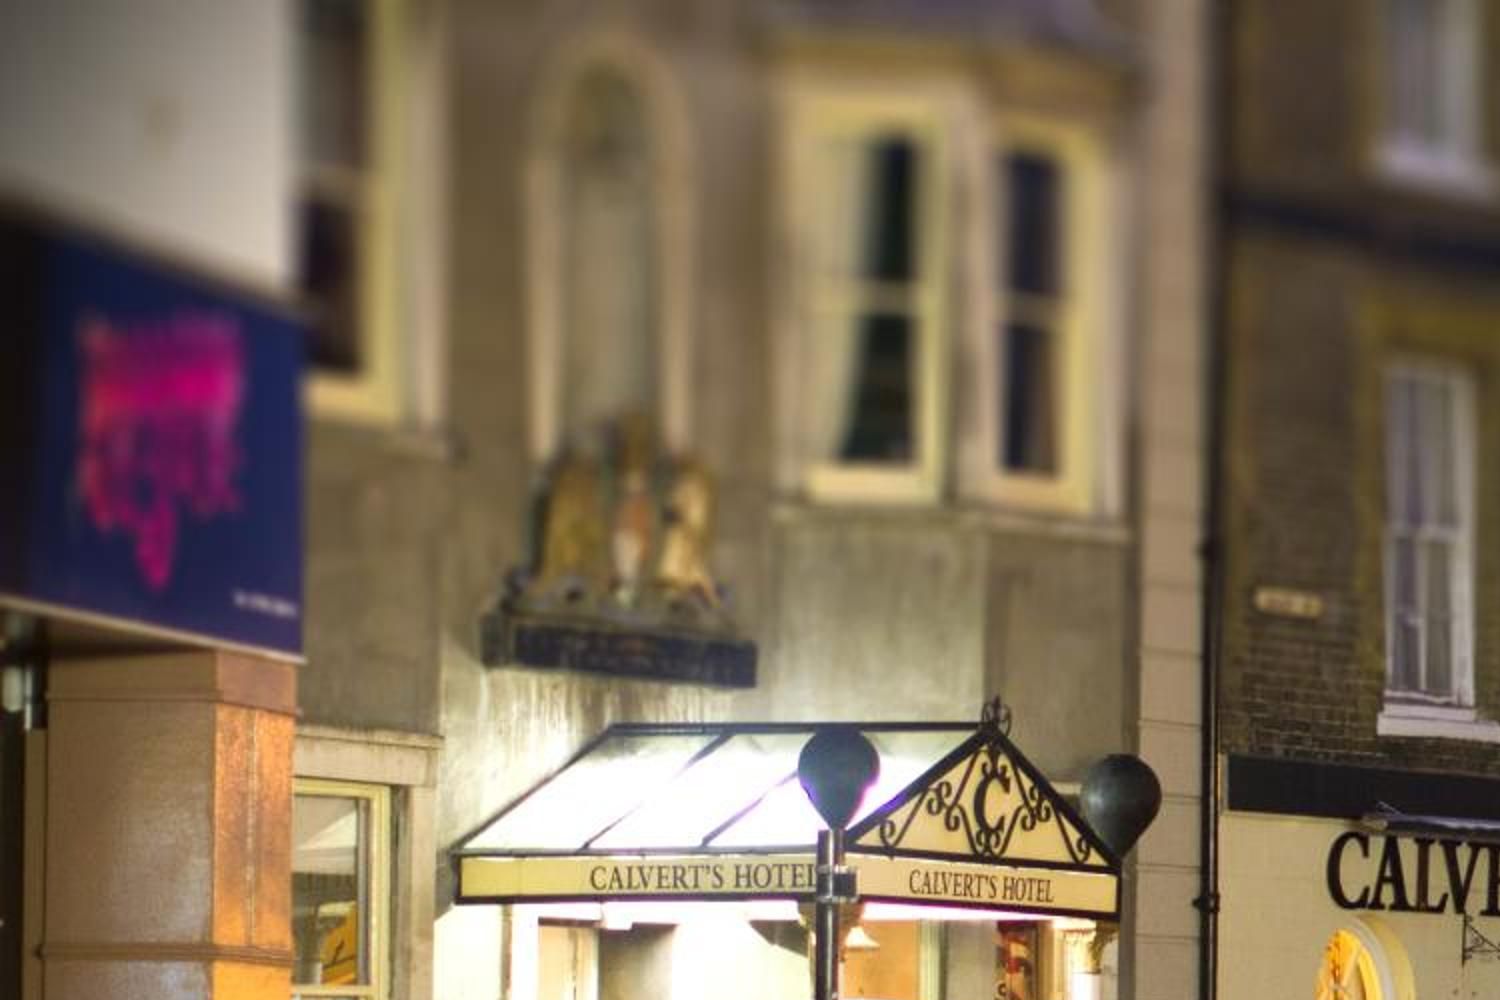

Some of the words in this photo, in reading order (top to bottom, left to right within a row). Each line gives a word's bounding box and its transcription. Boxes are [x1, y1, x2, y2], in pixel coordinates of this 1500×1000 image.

[589, 863, 724, 891] CALVERT'S
[908, 869, 998, 900] CALVERT'S
[1002, 876, 1055, 904] HOTEL
